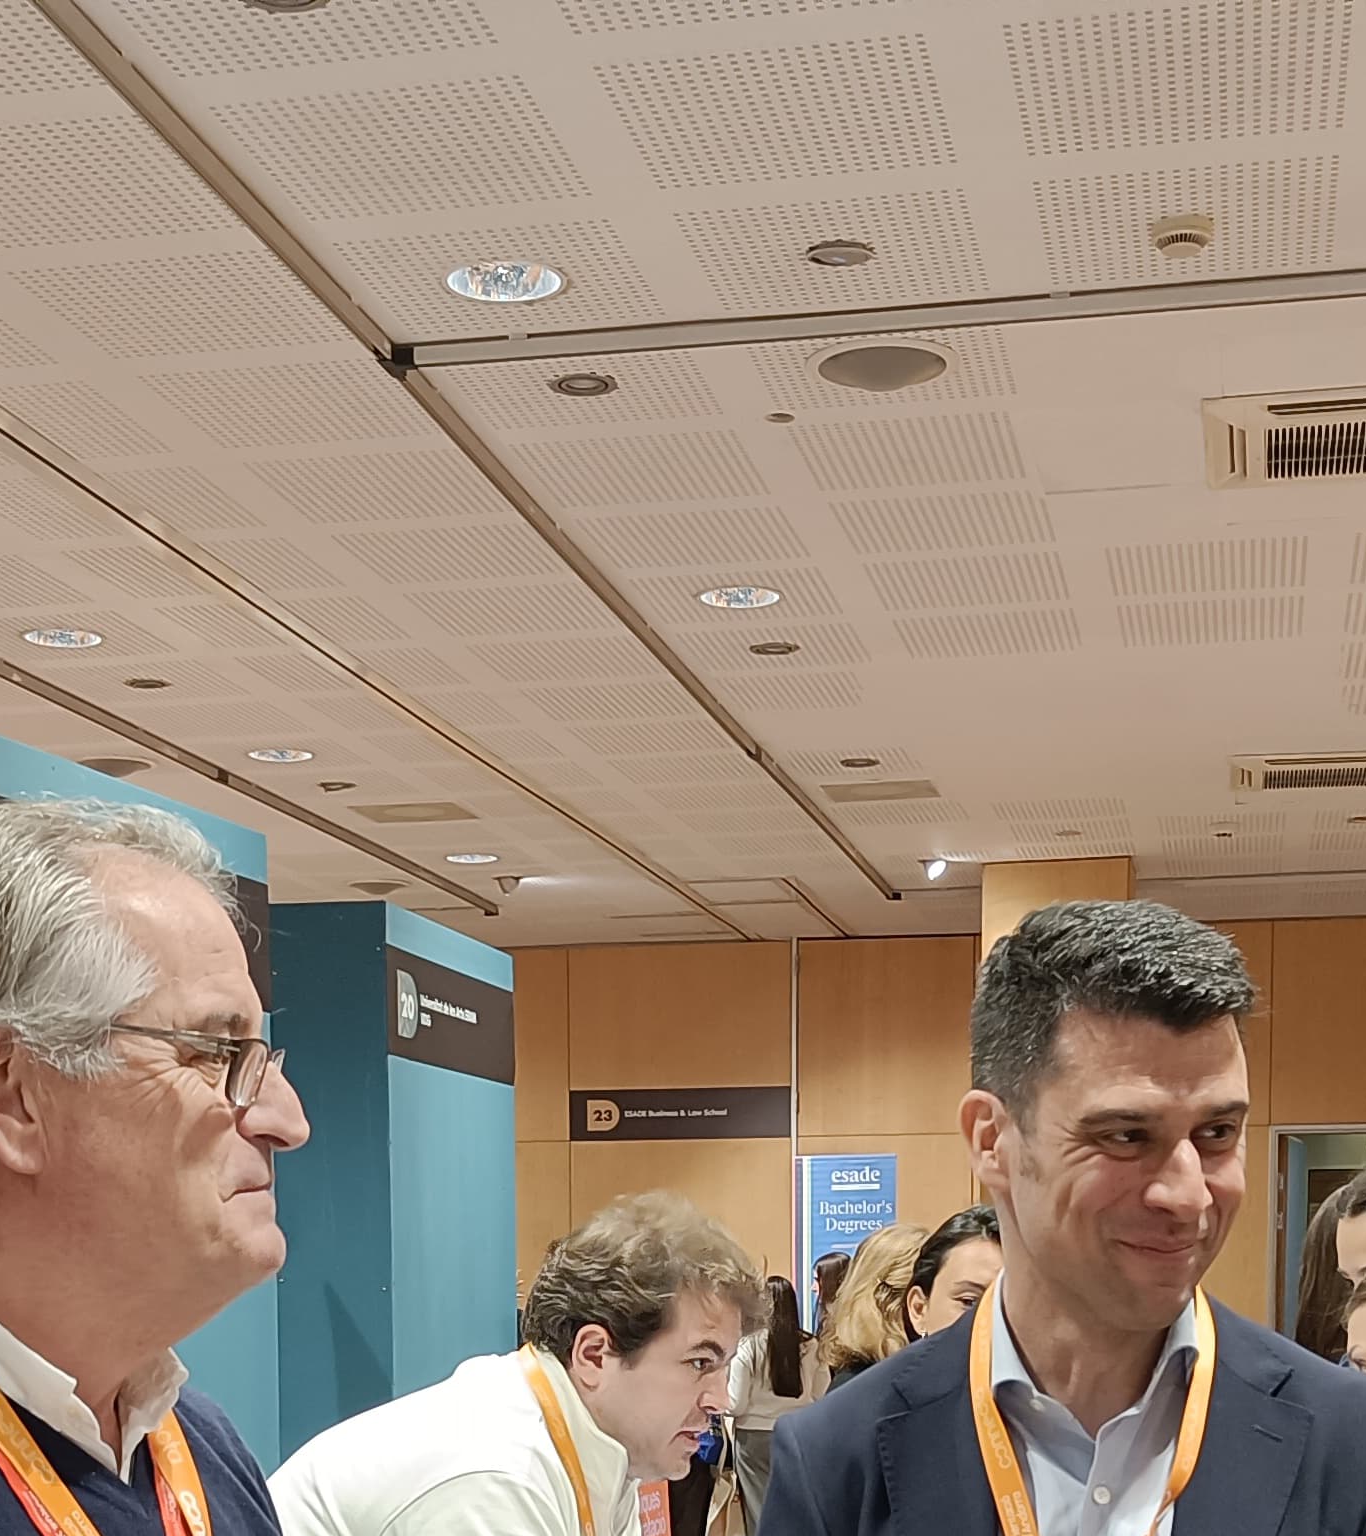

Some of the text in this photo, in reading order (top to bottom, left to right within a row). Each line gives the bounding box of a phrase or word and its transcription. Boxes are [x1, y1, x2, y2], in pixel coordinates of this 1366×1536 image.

[401, 992, 415, 1020] 20
[594, 1110, 613, 1121] 23
[831, 1165, 881, 1183] esade
[819, 1199, 893, 1215] Bachelor's
[826, 1217, 883, 1234] Degrees
